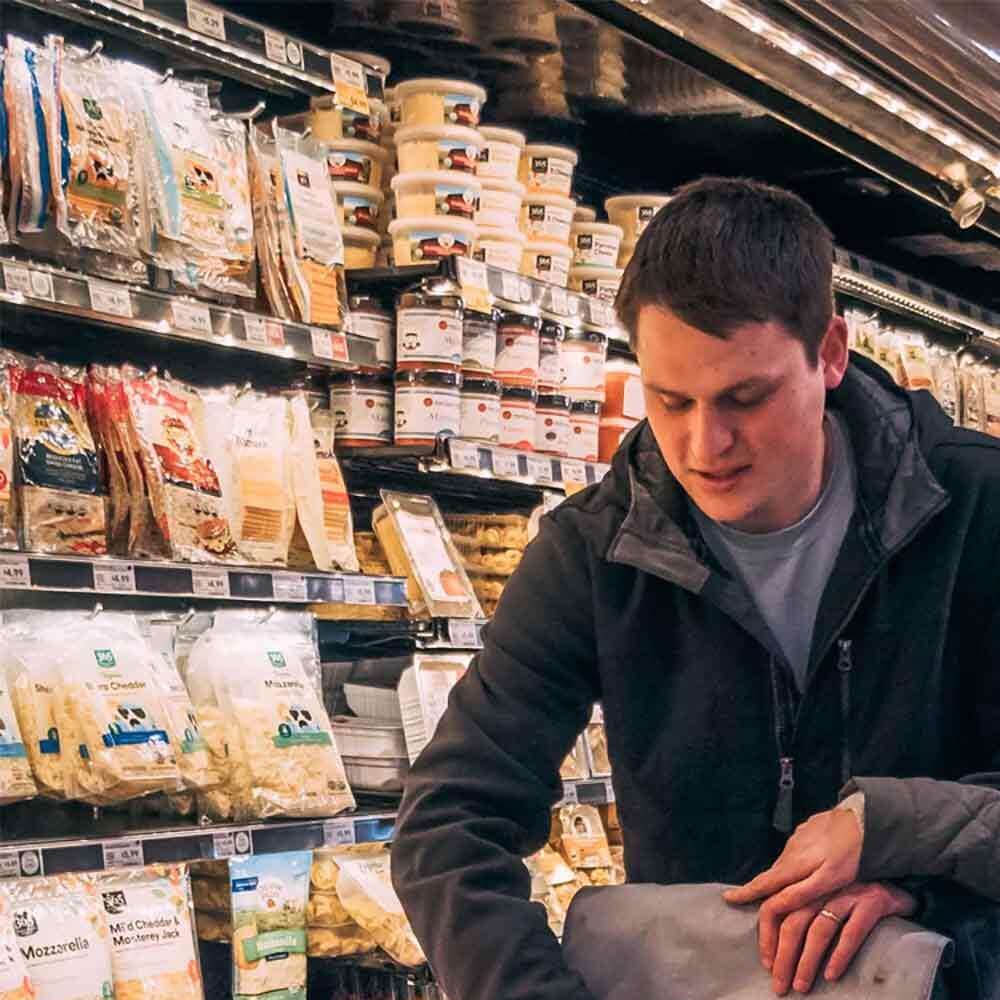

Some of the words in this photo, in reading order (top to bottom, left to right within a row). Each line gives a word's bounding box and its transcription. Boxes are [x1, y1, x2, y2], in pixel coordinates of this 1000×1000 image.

[109, 920, 134, 935] Mid
[135, 916, 172, 930] Cheddar
[162, 928, 180, 940] Jack
[20, 936, 89, 961] Mozzarella
